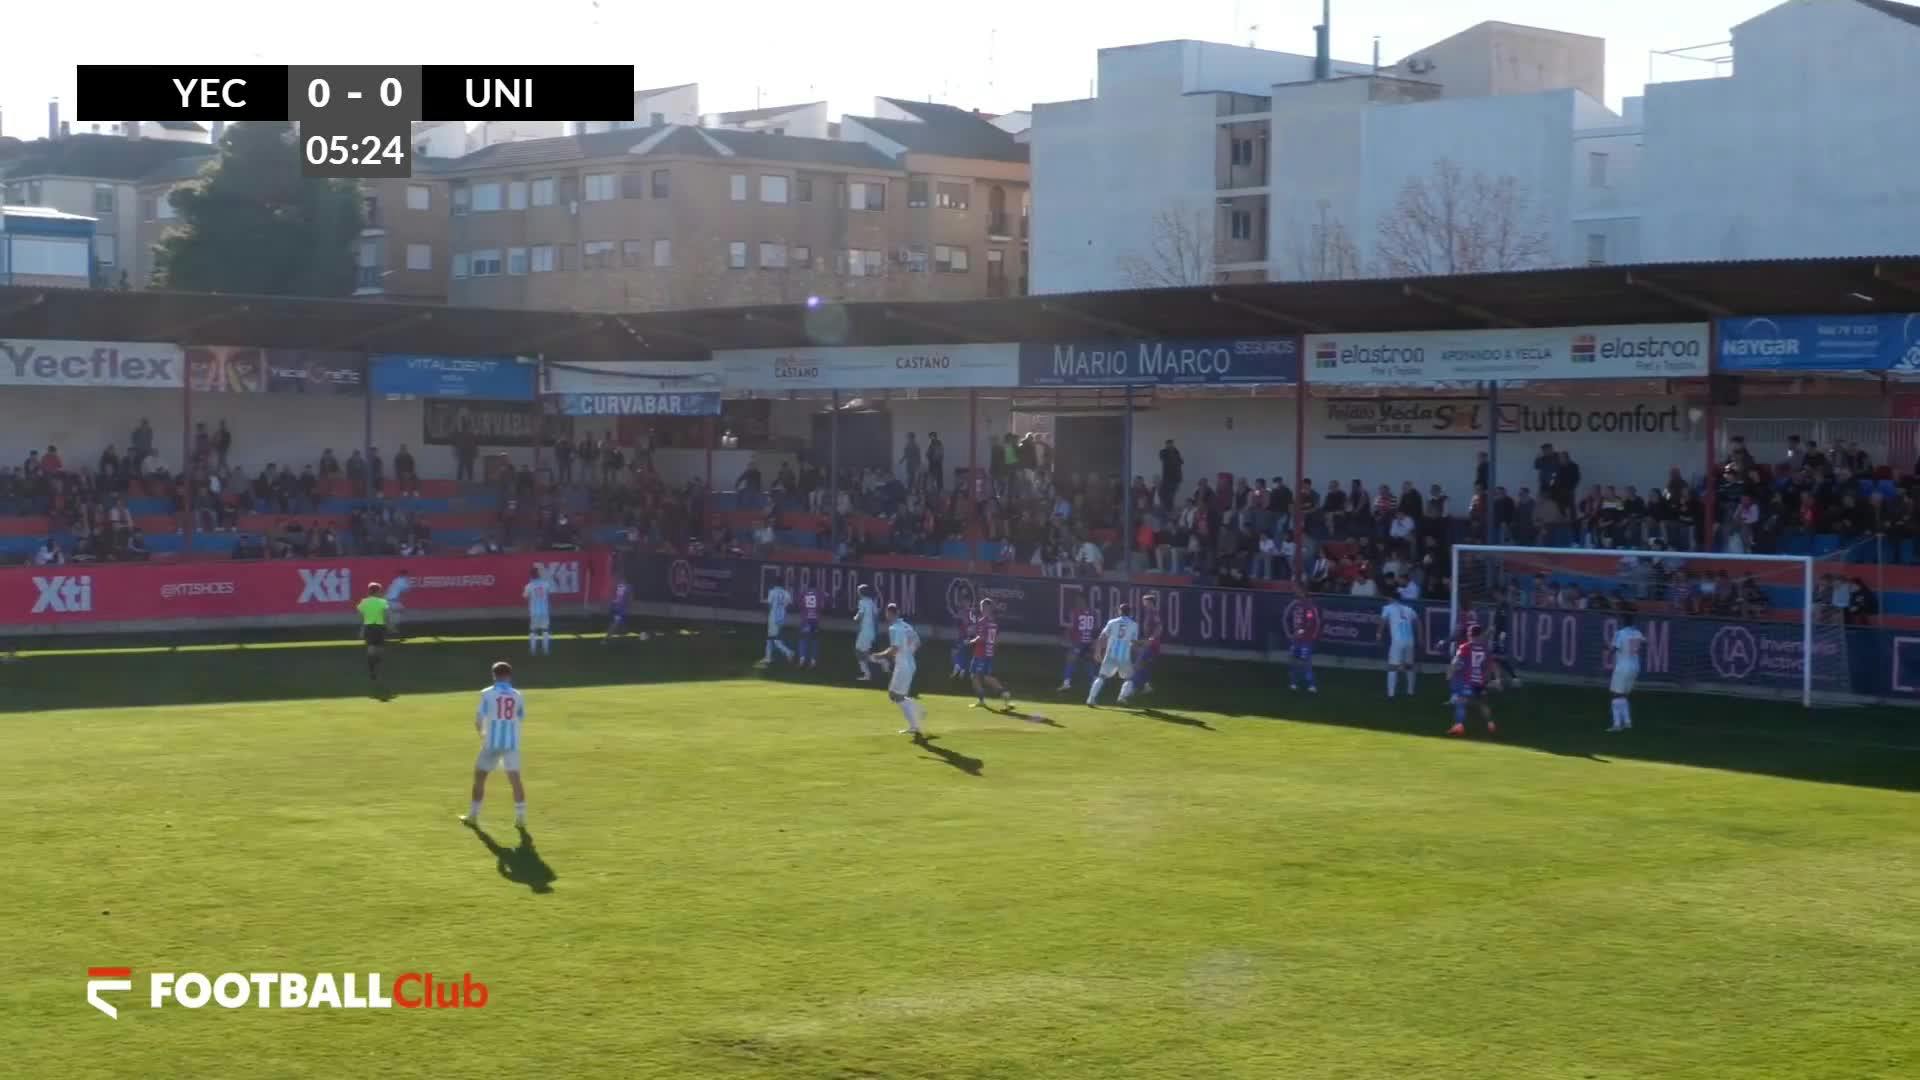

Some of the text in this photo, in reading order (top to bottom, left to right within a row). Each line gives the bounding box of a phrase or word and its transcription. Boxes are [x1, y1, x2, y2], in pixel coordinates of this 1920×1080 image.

[1341, 345, 1425, 364] elastron
[1601, 337, 1699, 358] elastron
[5, 346, 172, 380] Yecflex
[581, 396, 681, 414] CURVABAR
[1522, 402, 1680, 431] tutto confort
[298, 568, 351, 603] Xti
[533, 562, 580, 594] Xti
[32, 576, 91, 613] Xti
[1078, 615, 1095, 630] 30
[1200, 592, 1254, 642] SIM
[496, 696, 515, 720] 18
